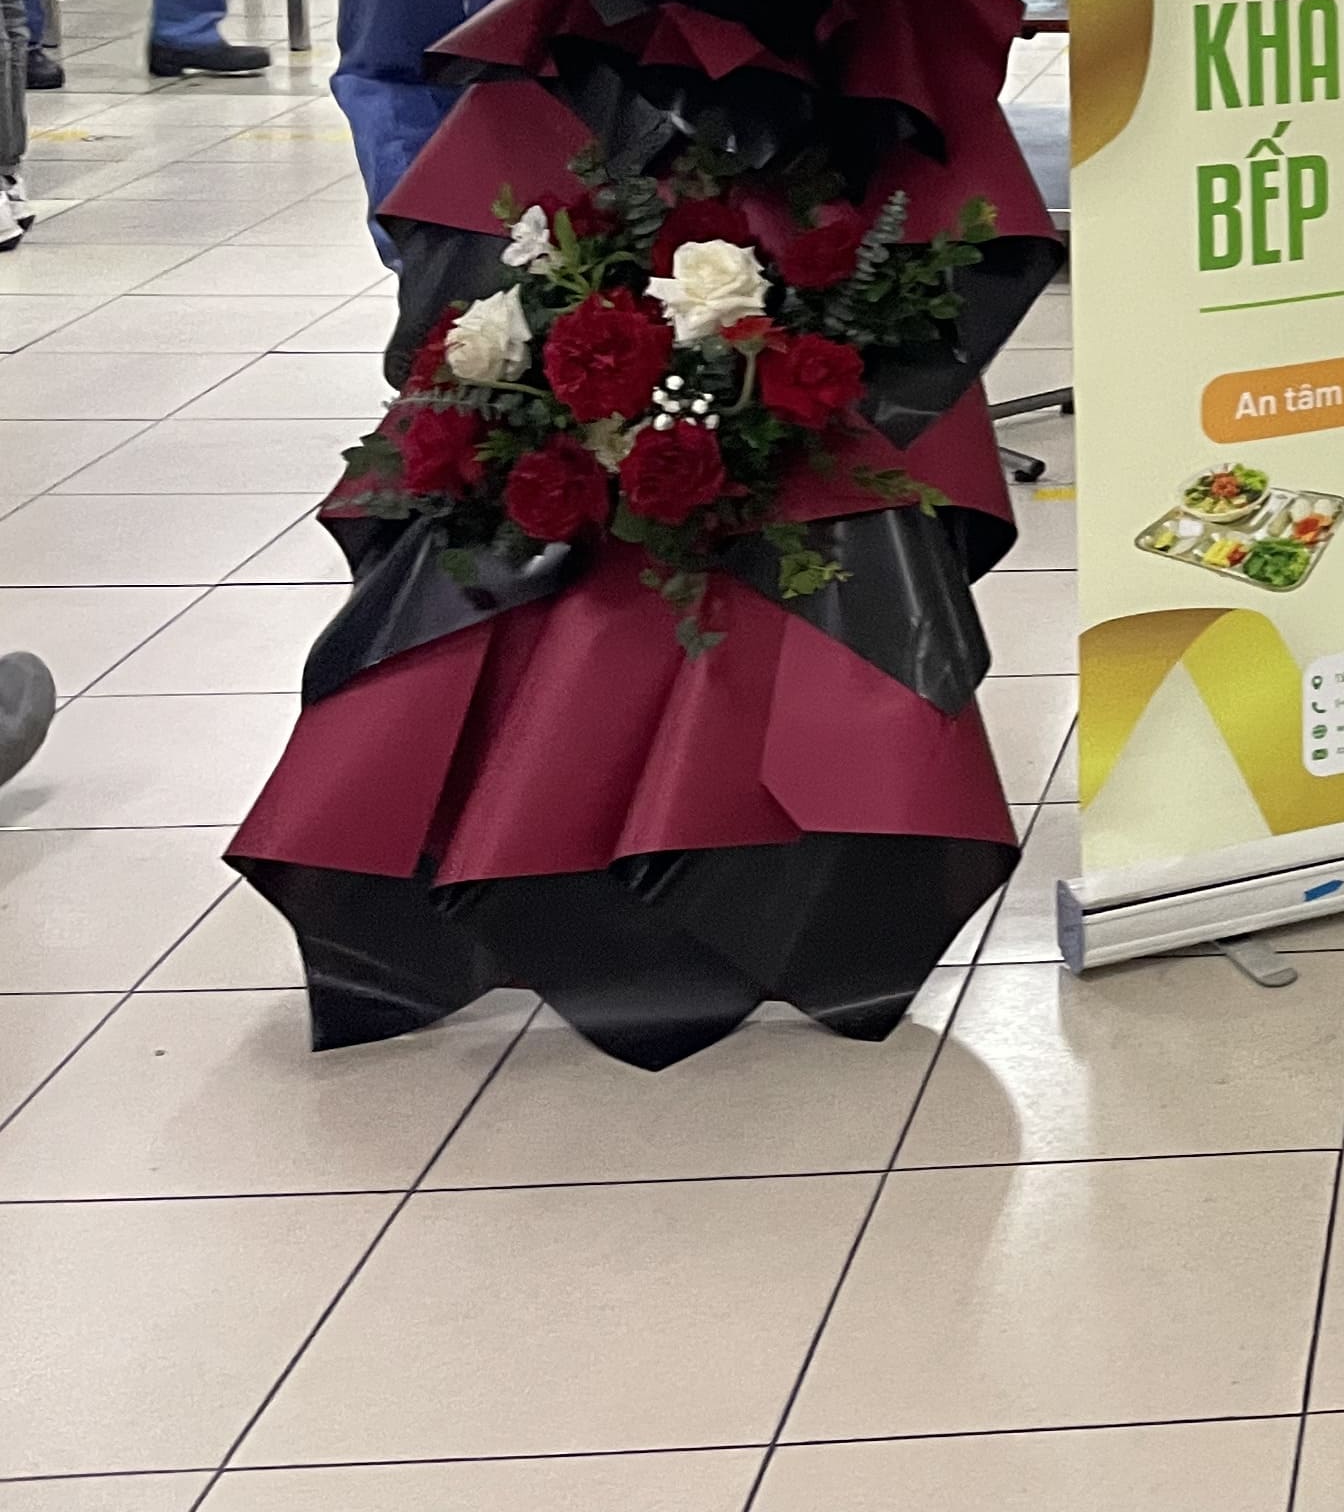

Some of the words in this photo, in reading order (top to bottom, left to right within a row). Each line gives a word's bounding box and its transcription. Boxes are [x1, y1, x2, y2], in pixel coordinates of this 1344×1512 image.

[1197, 120, 1328, 272] BẾP
[1235, 391, 1277, 419] An
[1284, 384, 1343, 413] tâm
